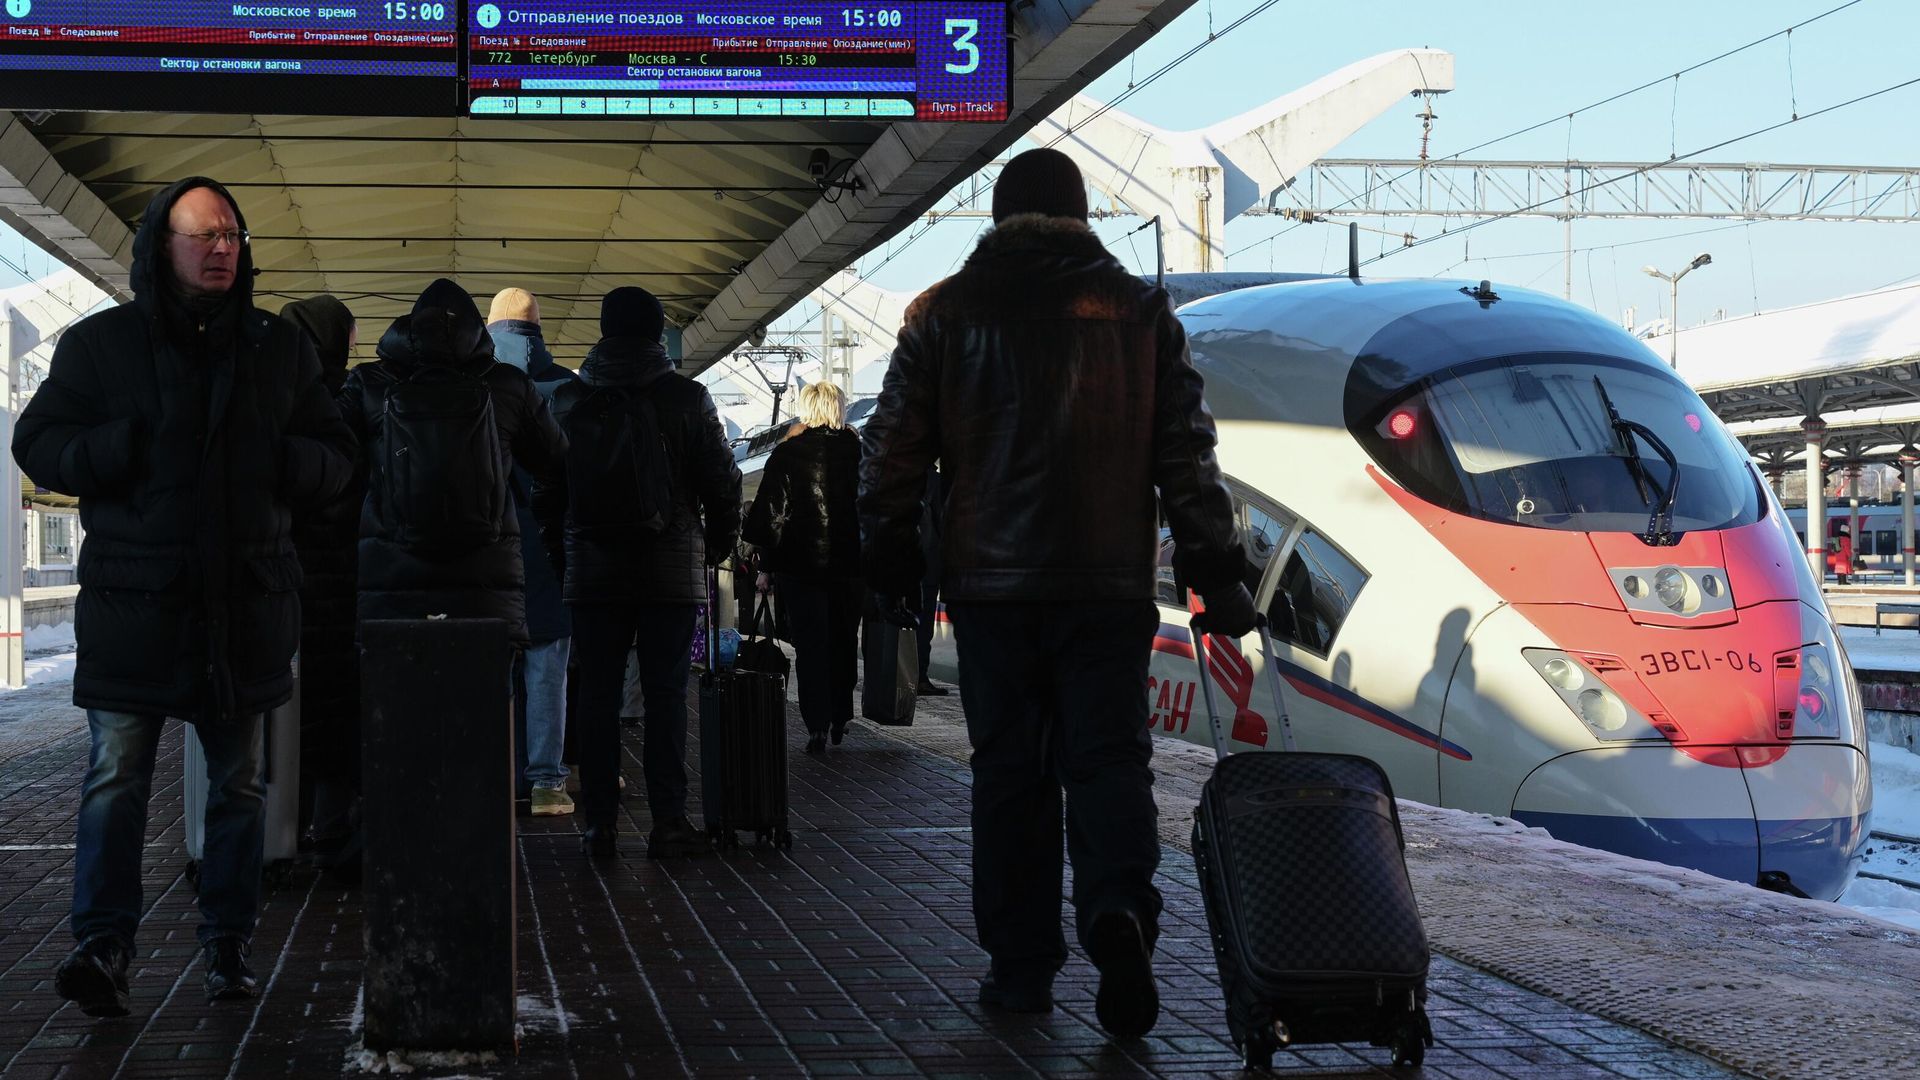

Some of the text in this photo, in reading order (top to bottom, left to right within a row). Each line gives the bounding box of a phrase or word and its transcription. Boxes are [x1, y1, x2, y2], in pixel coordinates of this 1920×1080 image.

[232, 4, 357, 20] Московское время
[383, 2, 445, 21] 15:00
[508, 10, 683, 26] Отправление поездов
[696, 13, 822, 29] Московское время
[842, 9, 902, 27] 15:00
[8, 26, 40, 37] Поезд
[60, 27, 119, 38] Следование
[249, 31, 296, 41] Прибытие
[303, 31, 368, 42] Отправление
[479, 36, 509, 46] Поезд
[529, 37, 587, 47] Следование
[712, 38, 758, 49] Прибытие
[766, 39, 828, 49] Отправление
[945, 19, 980, 74] 3
[488, 52, 512, 63] 772
[629, 53, 676, 64] Москва
[778, 55, 817, 66] 15:30
[160, 57, 301, 71] Сектор остановки вагона
[627, 67, 762, 78] Сектор остановки вагона
[503, 100, 514, 108] 10
[536, 100, 542, 108] 9
[580, 100, 587, 109] 8
[625, 100, 631, 109] 7
[669, 100, 675, 109] 6
[713, 101, 719, 110] 5
[756, 101, 763, 110] 4
[800, 101, 807, 110] 3
[844, 102, 850, 110] 2
[932, 102, 957, 113] Путь
[966, 102, 994, 112] Track
